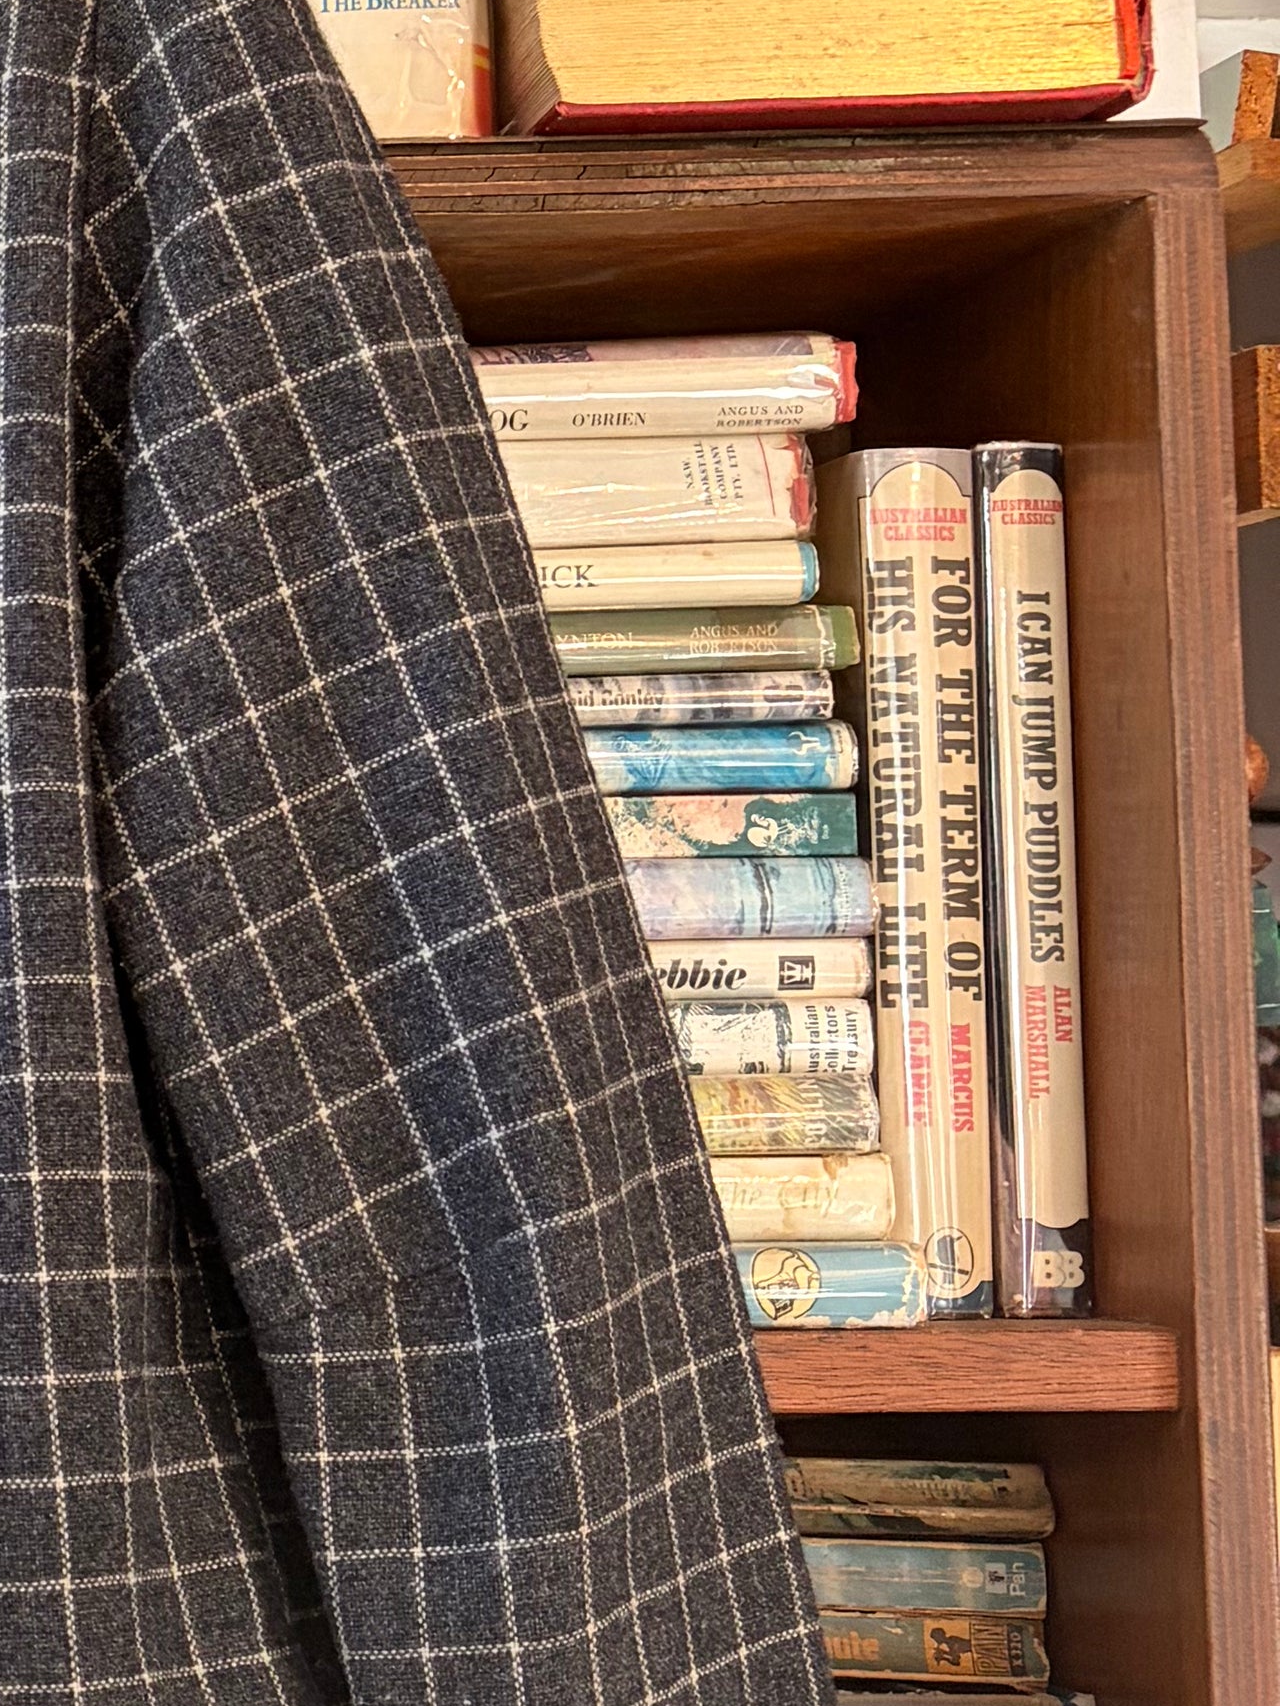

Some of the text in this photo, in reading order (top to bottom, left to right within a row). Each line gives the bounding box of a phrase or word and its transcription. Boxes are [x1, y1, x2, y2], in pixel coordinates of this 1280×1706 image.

[571, 410, 648, 429] O'BRIEN
[716, 416, 803, 429] ROBERTSON
[717, 403, 804, 418] ANGUS AND
[883, 525, 956, 543] CLASSICS
[1000, 512, 1057, 526] CLASSICS
[930, 555, 984, 1002] FOR THE TERM OF
[1051, 983, 1074, 1044] ALAN
[1023, 983, 1051, 1101] MARSHALL
[905, 1019, 934, 1129] CLARKE
[948, 1022, 974, 1133] MARCUS
[1037, 1248, 1087, 1289] BB
[1009, 1561, 1026, 1597] Pan
[973, 1623, 1011, 1676] PAN
